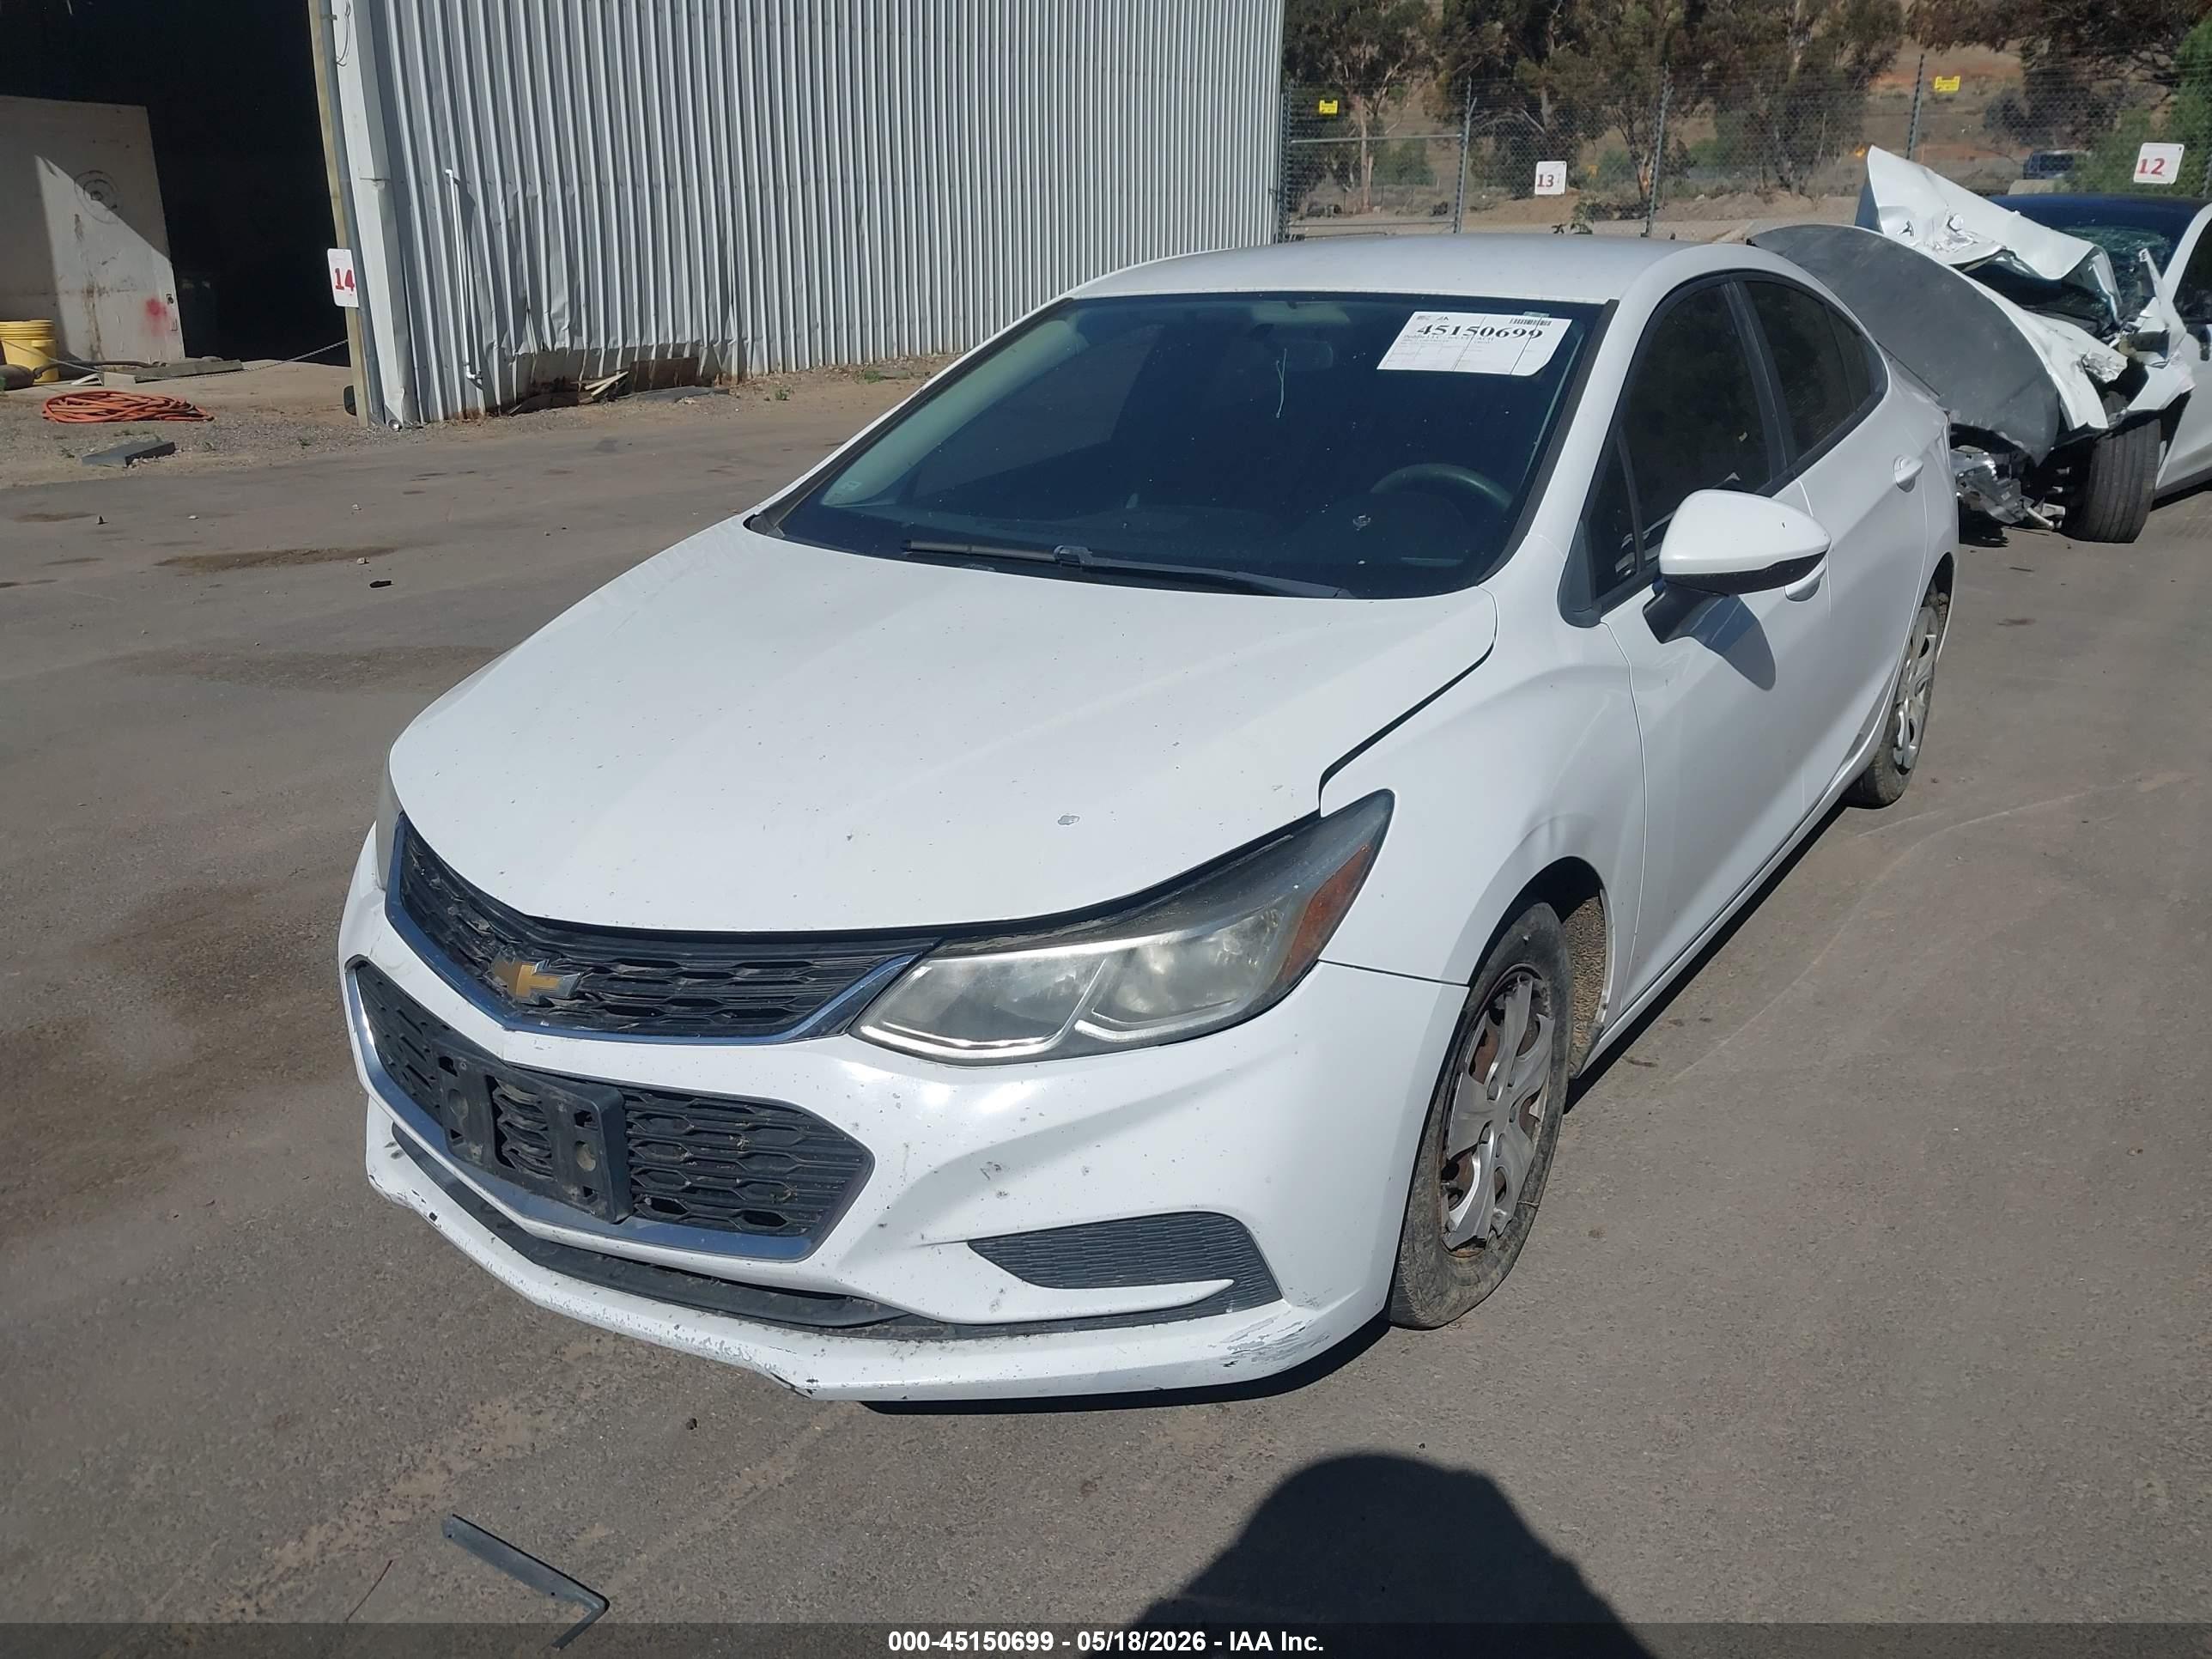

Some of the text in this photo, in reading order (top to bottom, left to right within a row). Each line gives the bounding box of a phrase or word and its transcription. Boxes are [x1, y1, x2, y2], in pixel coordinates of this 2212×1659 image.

[2139, 158, 2165, 175] 12
[1537, 174, 1554, 187] 13
[335, 268, 355, 292] 14
[1417, 324, 1543, 340] 45150699
